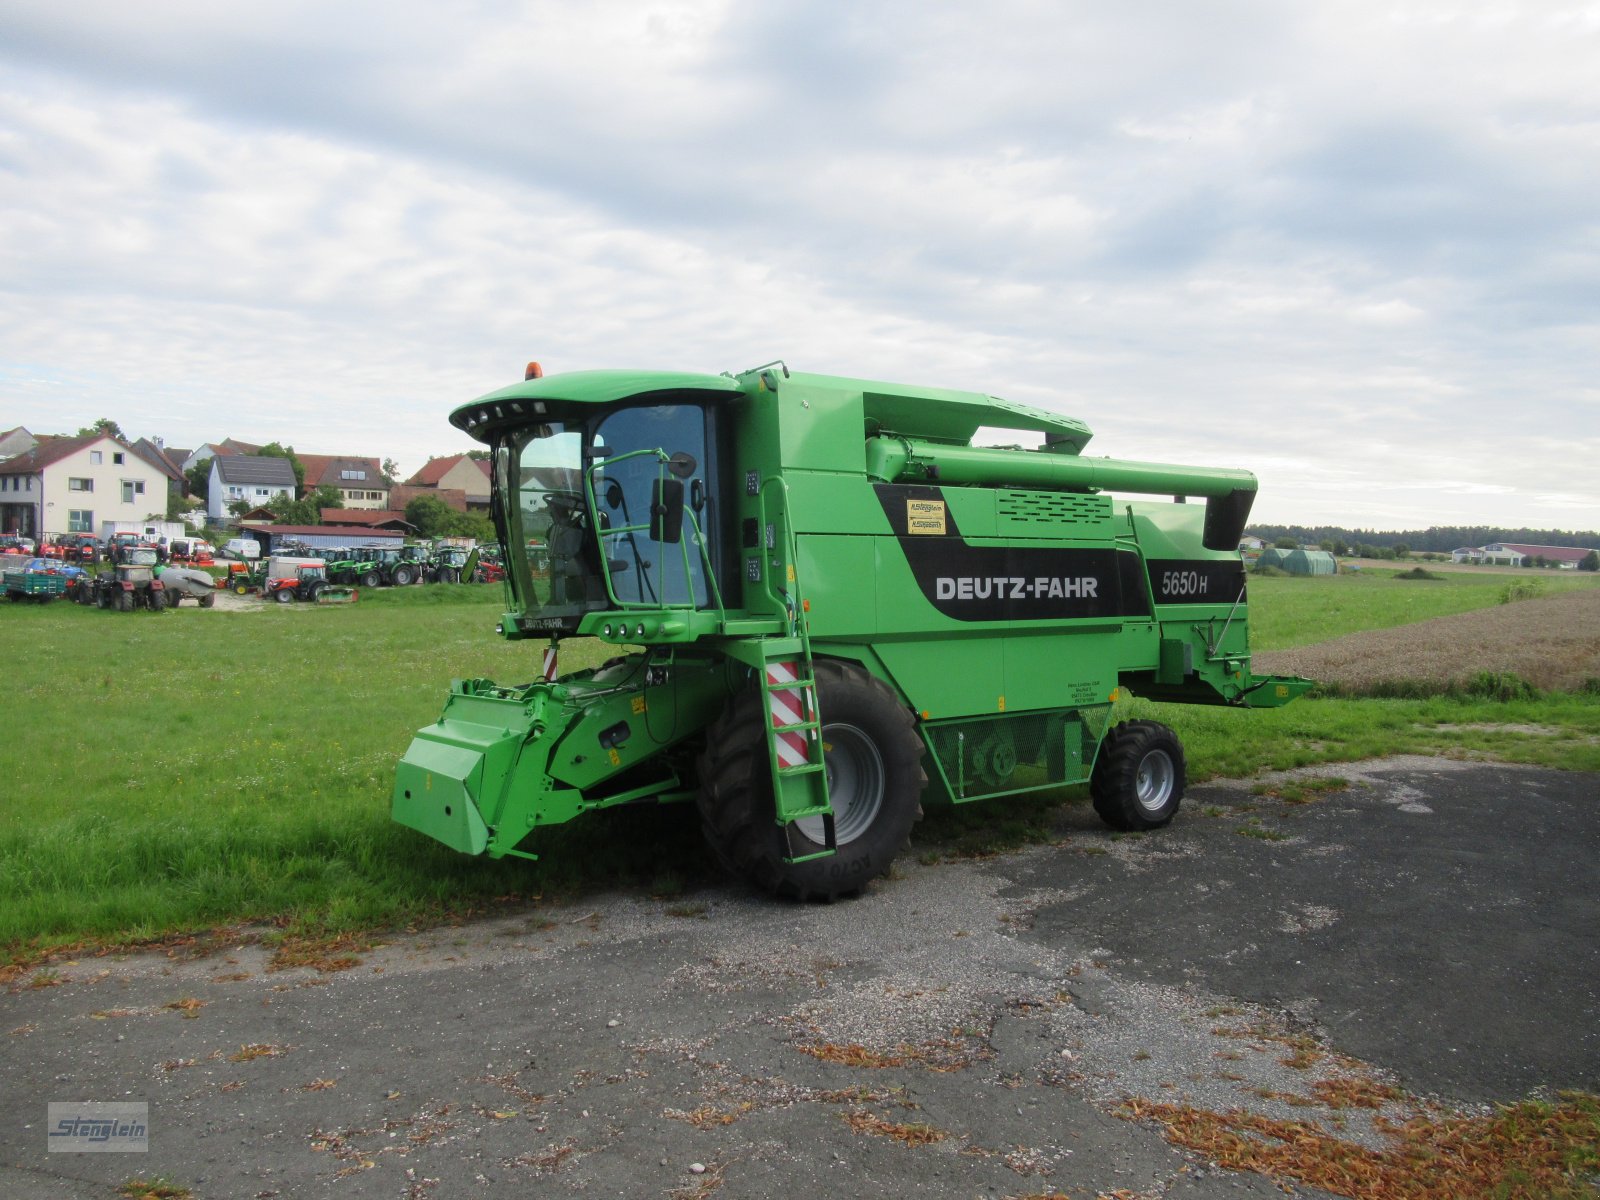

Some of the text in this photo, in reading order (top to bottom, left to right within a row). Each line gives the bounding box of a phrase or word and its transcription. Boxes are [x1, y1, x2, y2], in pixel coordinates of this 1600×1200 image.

[936, 577, 1098, 600] DEUTZ-FAHR
[1162, 571, 1208, 595] 5650 H
[525, 618, 563, 629] DEUTZ-FAHR
